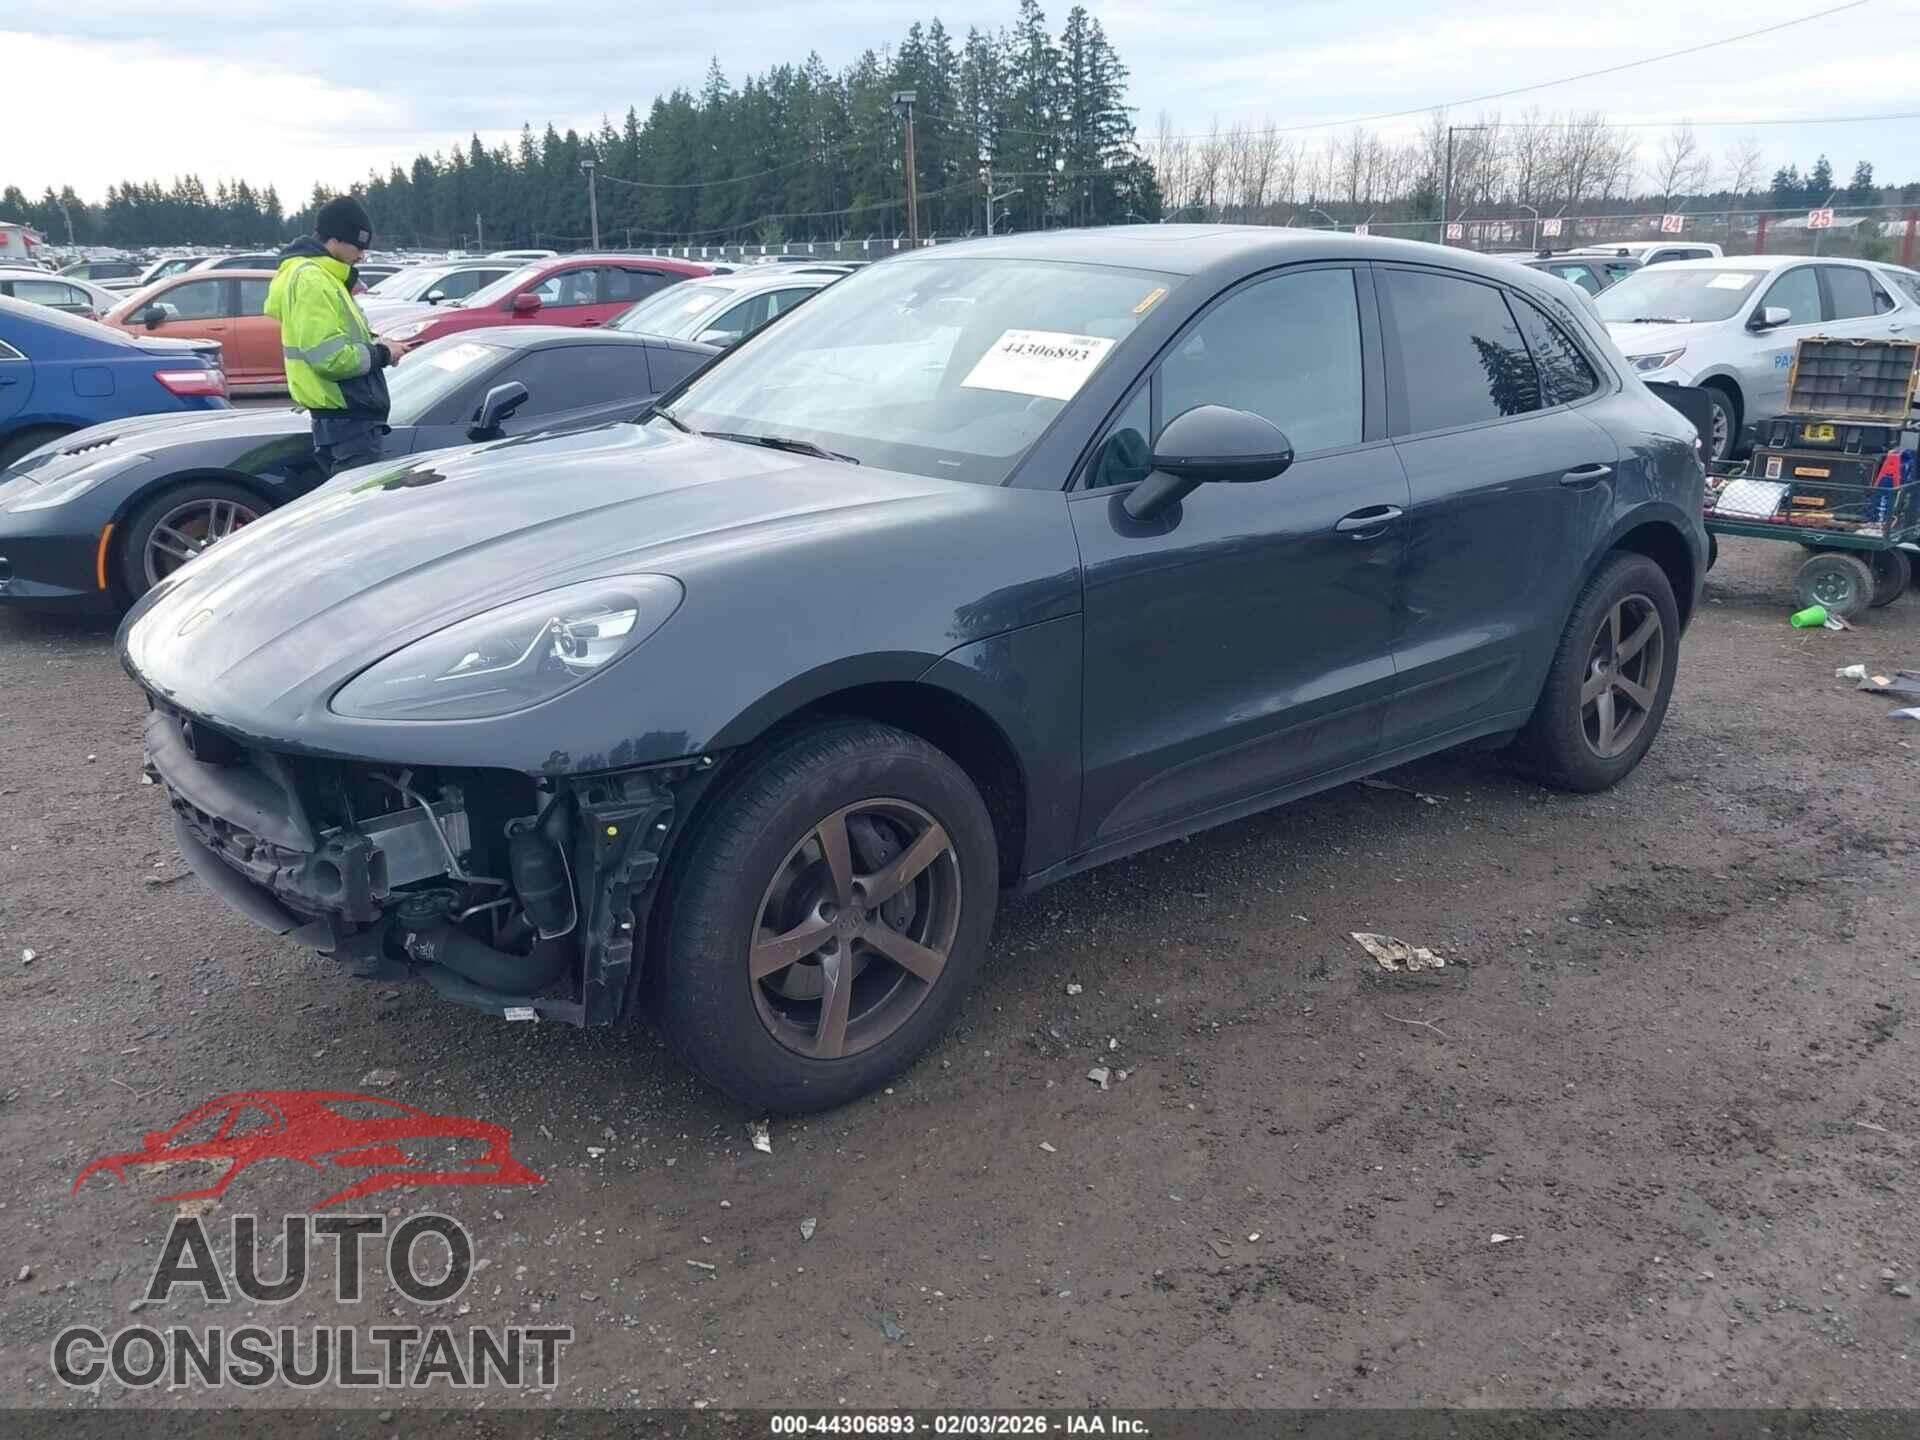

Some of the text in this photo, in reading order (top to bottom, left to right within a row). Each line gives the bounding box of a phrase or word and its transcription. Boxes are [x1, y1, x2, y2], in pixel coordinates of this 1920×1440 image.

[1663, 216, 1680, 231] 24
[1810, 210, 1830, 227] 25
[1448, 224, 1461, 238] 22
[1002, 342, 1089, 361] 44306893
